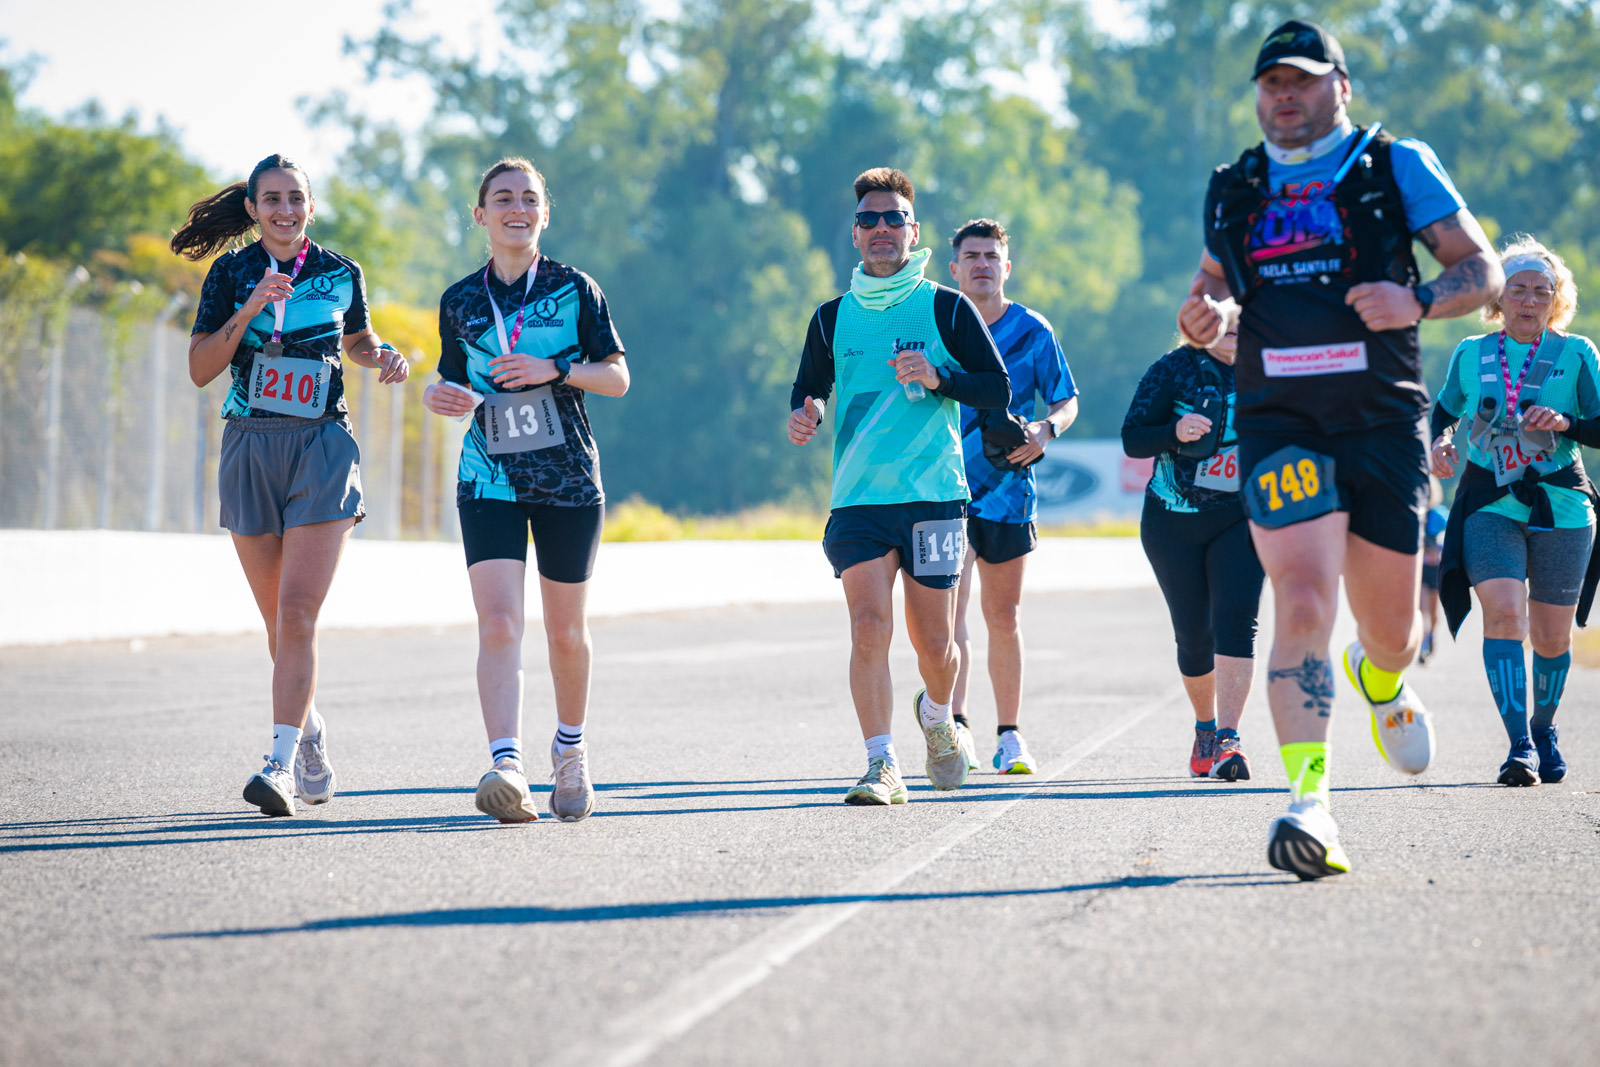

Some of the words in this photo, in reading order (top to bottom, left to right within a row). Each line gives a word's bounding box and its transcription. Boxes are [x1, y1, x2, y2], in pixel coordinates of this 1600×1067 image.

[1328, 258, 1341, 272] FE
[466, 316, 488, 327] INVICTO
[544, 318, 564, 327] TEAM
[843, 350, 864, 358] INVICTO
[1325, 345, 1359, 359] Salud
[254, 363, 264, 399] TIEMPO
[262, 368, 314, 404] 210
[311, 372, 322, 408] EXACTO
[490, 405, 500, 443] TIEMPO
[504, 404, 539, 438] 13
[541, 398, 555, 437] EXACTO
[1208, 453, 1241, 479] 26
[1258, 458, 1320, 512] 748
[917, 530, 927, 565] TIEMPO
[927, 531, 964, 562] 145
